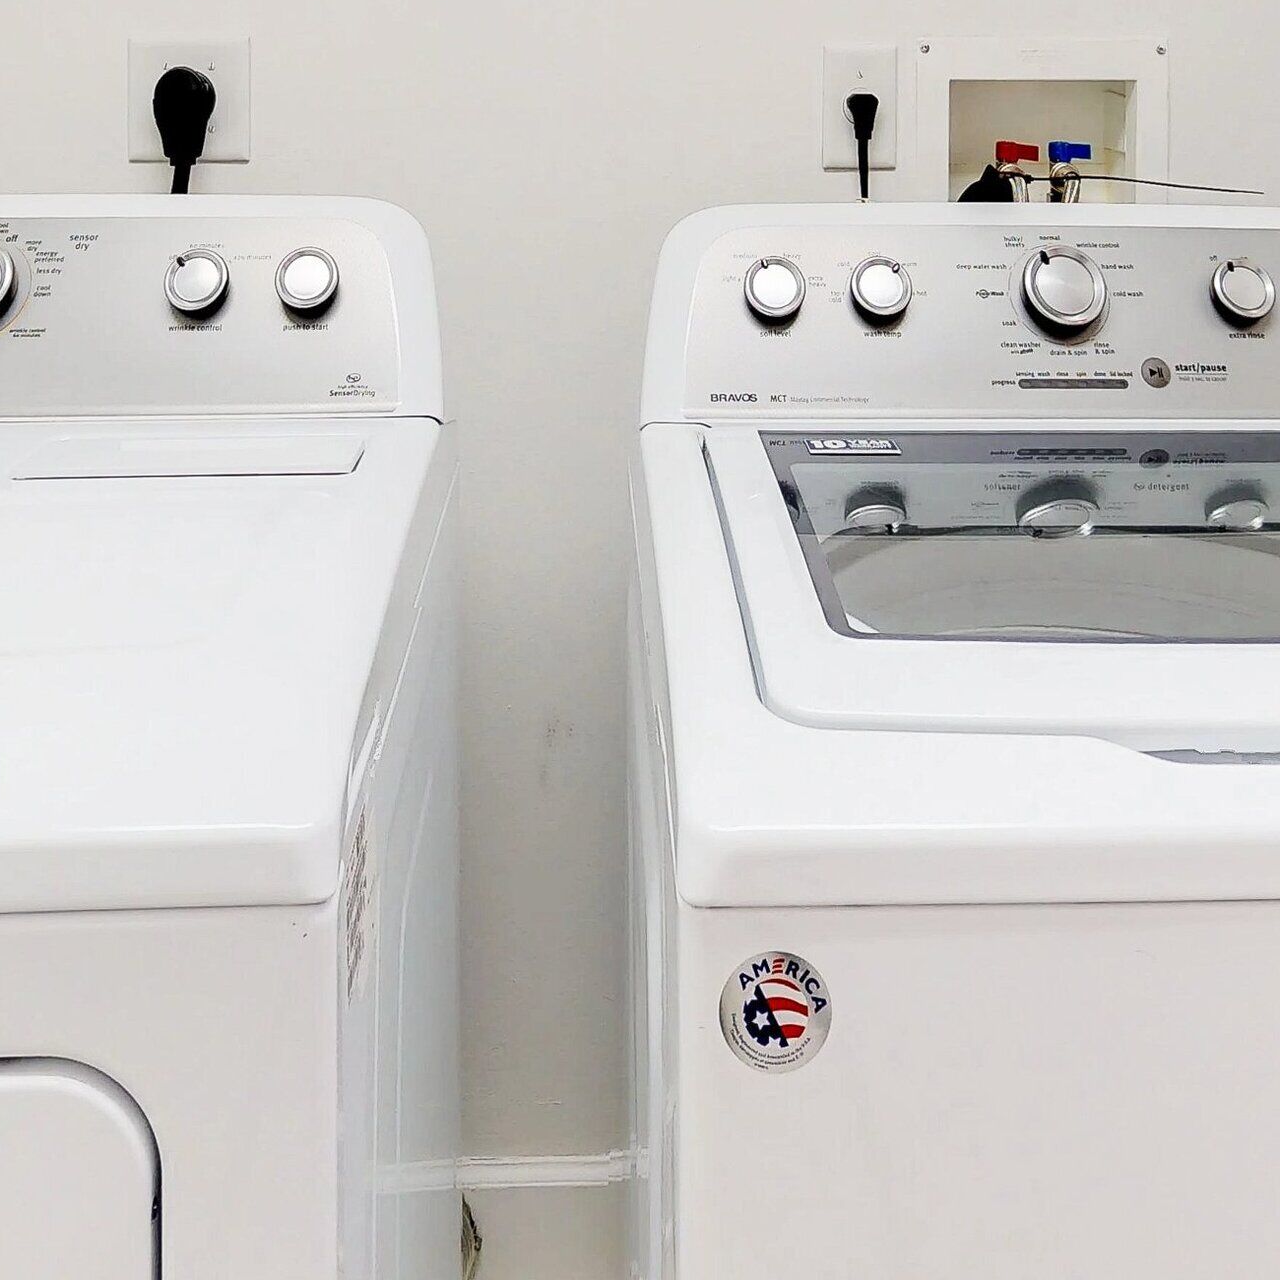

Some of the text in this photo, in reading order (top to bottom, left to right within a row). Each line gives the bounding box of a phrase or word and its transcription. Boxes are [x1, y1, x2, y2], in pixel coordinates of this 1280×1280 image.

[5, 234, 18, 243] off
[69, 234, 99, 242] sensor
[75, 241, 90, 251] dry
[197, 323, 222, 331] control
[283, 324, 301, 332] push
[311, 323, 328, 331] start
[884, 330, 902, 338] temp
[1175, 362, 1227, 374] start/pause
[711, 393, 757, 402] BRAVOS
[770, 395, 787, 403] MCT
[739, 958, 827, 1014] AMERICA
